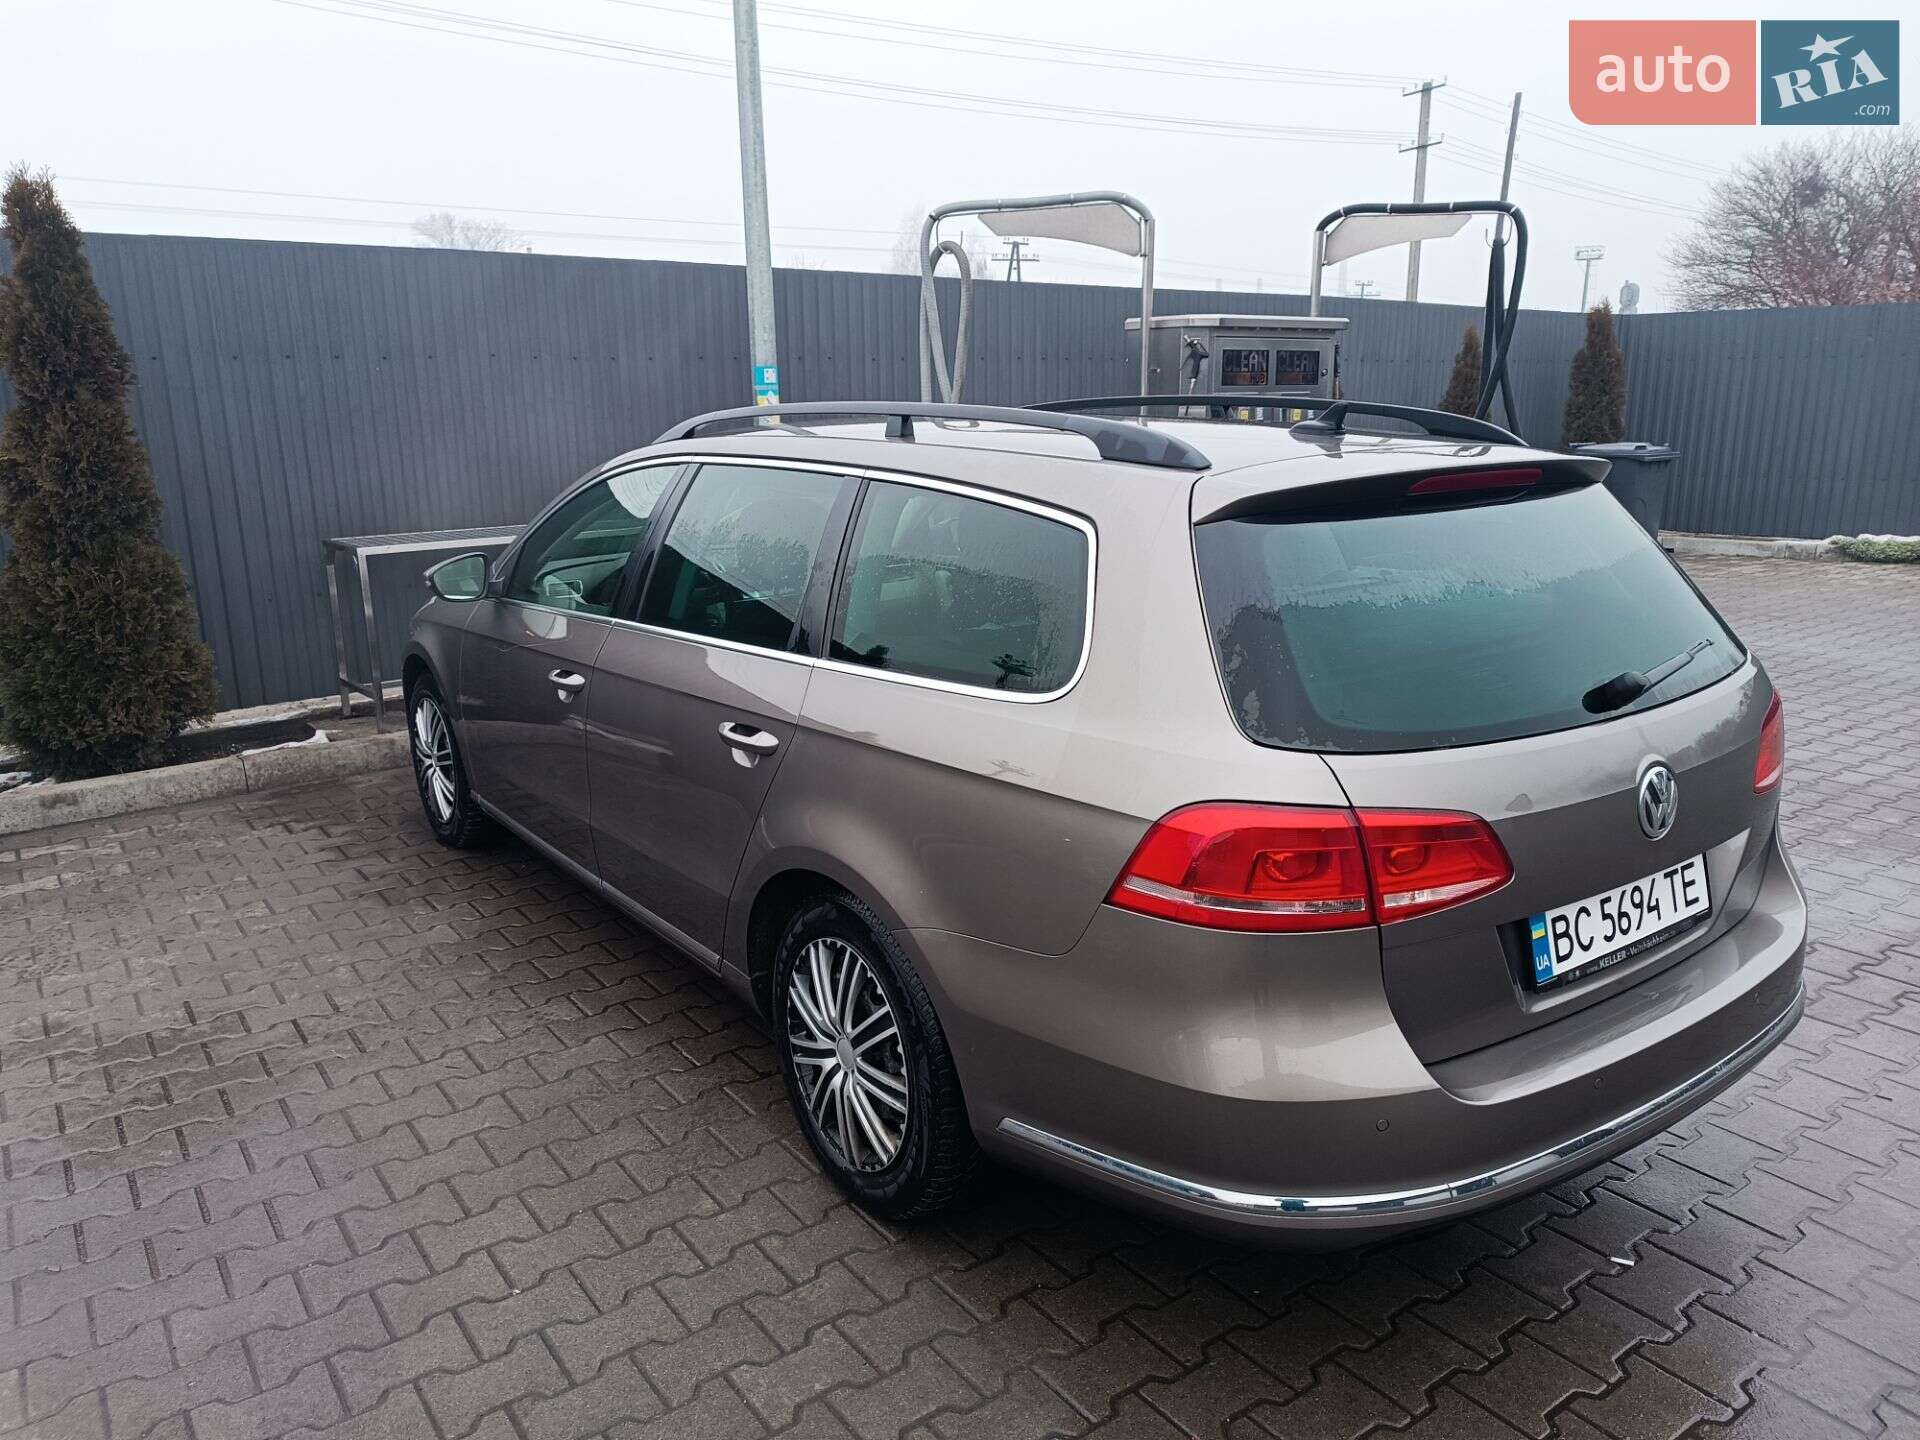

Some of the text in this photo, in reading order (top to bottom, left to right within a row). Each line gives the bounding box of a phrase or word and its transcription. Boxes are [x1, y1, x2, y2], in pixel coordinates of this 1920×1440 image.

[1223, 350, 1267, 372] CLEAN
[1551, 905, 1594, 964] BC
[1600, 878, 1662, 943] 5694
[1663, 861, 1700, 913] TE
[1536, 954, 1550, 971] UA
